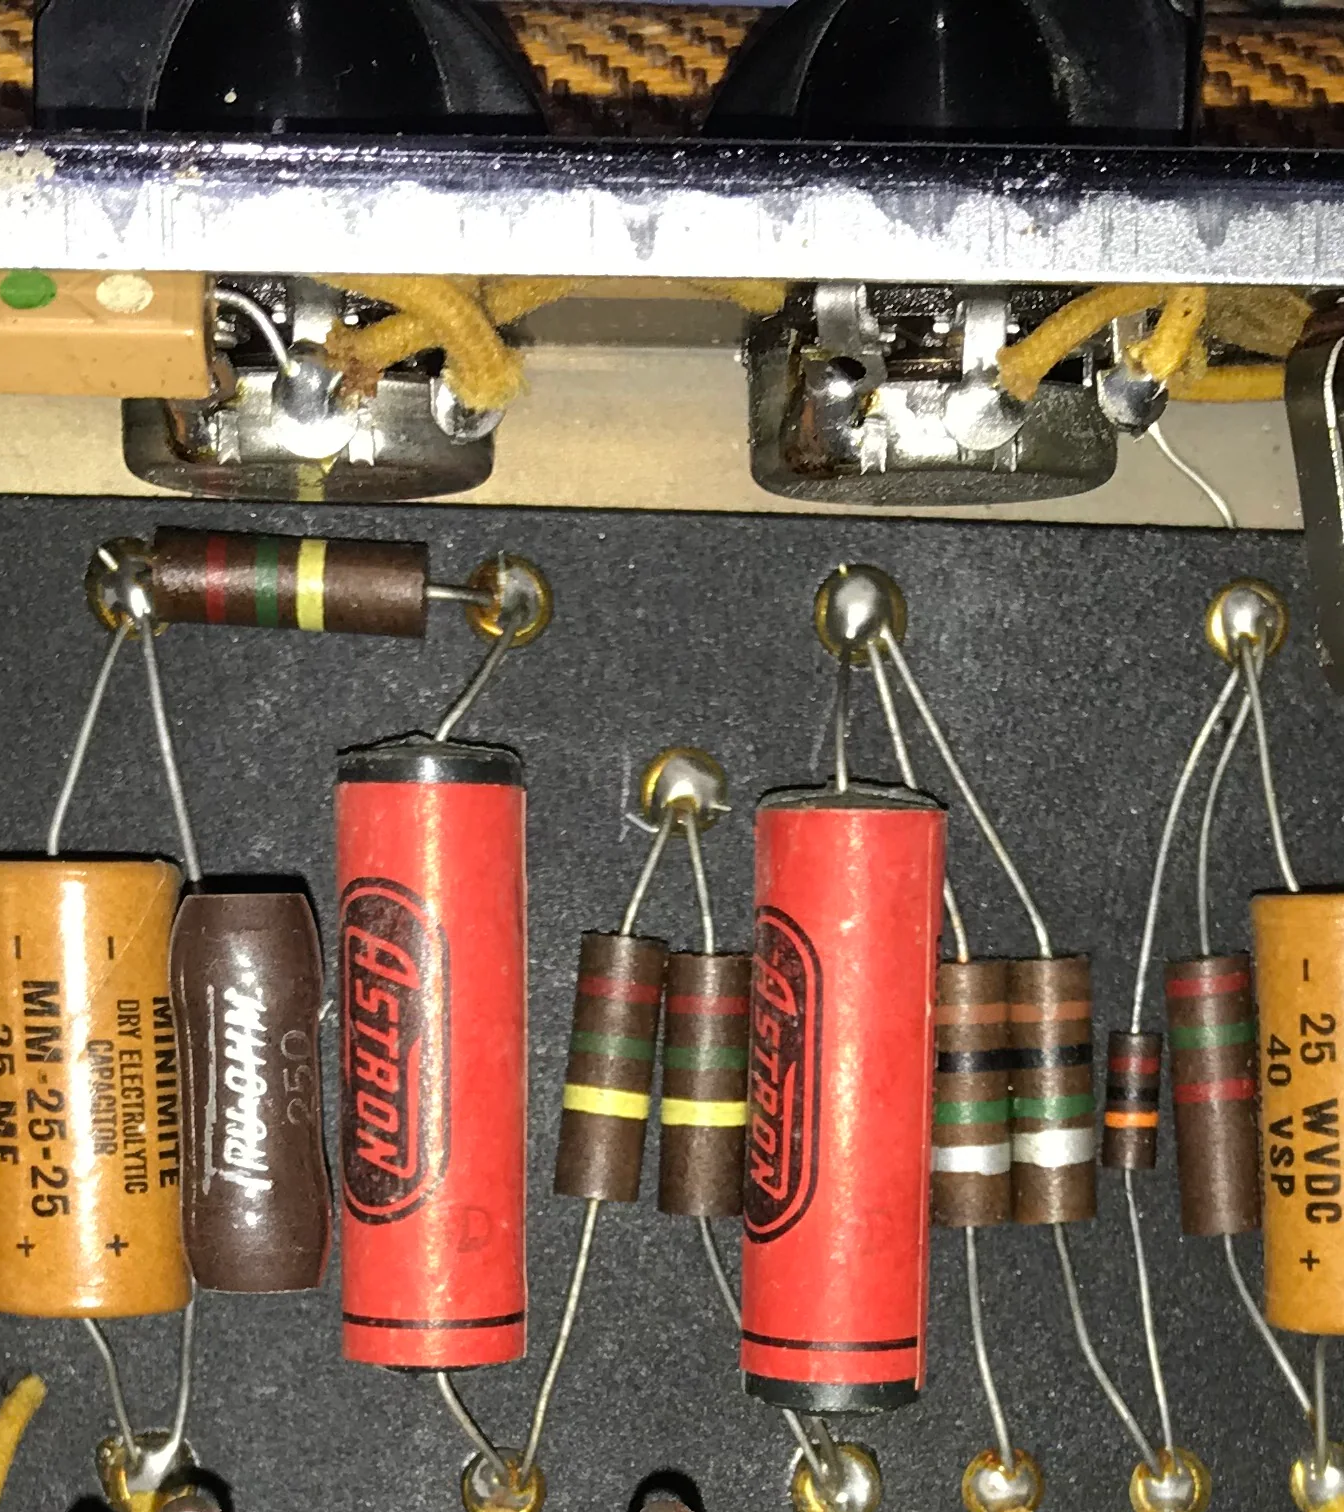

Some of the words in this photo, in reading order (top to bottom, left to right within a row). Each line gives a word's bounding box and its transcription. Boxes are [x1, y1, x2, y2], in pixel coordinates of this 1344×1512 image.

[116, 999, 143, 1038] DRY
[281, 1029, 316, 1125] 250
[344, 932, 420, 1182] ASTRON
[1267, 1034, 1291, 1087] 40
[1300, 1013, 1336, 1065] 25
[22, 980, 71, 1218] MM-25-25
[87, 1040, 118, 1156] CAPACITOR
[120, 1049, 148, 1194] ELECTROLYTIC
[153, 996, 181, 1188] MINIMITE
[748, 959, 798, 1202] ASTRON
[1268, 1116, 1295, 1198] VSP
[1302, 1098, 1342, 1225] WVDC
